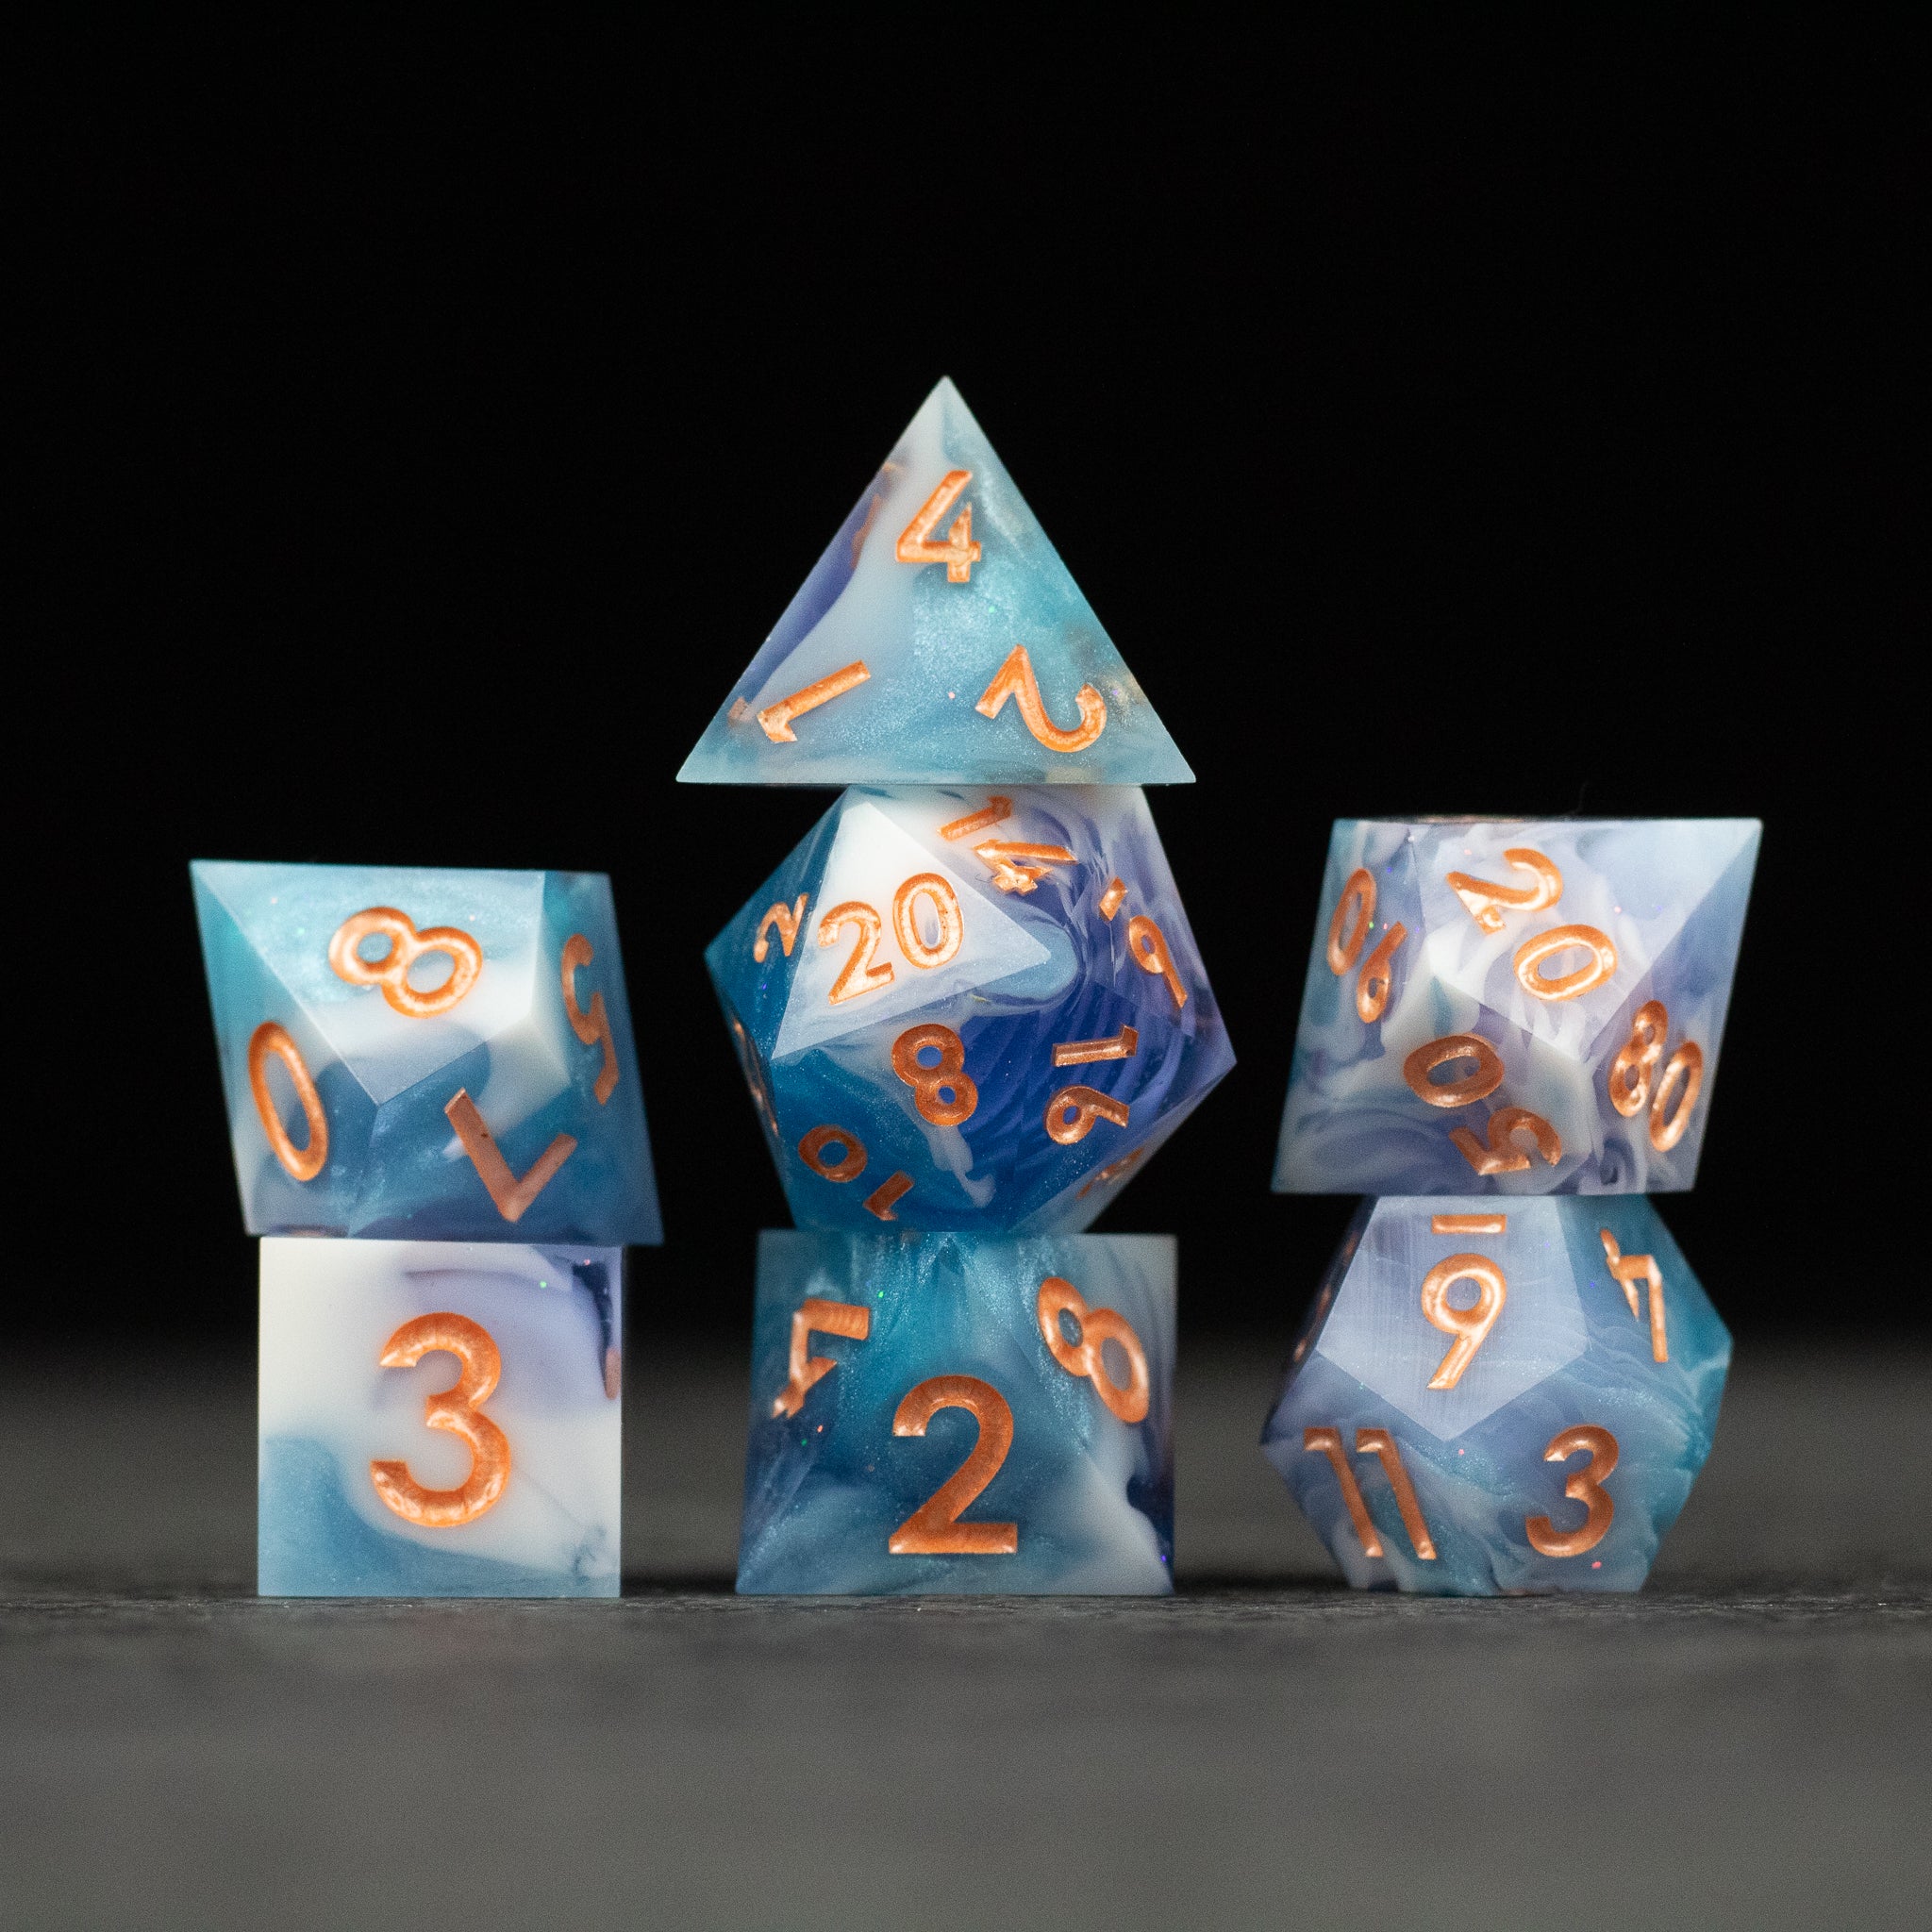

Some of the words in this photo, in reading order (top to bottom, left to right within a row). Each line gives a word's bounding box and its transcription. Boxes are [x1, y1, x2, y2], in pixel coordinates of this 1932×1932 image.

[896, 470, 981, 582] 4
[758, 659, 871, 742] 1
[974, 644, 1108, 753] 2
[328, 907, 483, 1019] 8
[753, 893, 809, 962] 2
[817, 873, 963, 1005] 20
[1446, 847, 1617, 1002] 20
[247, 1021, 328, 1182] 0
[891, 1023, 978, 1126] 8
[1044, 1024, 1140, 1145] 16
[1402, 1034, 1562, 1177] 50
[1608, 1000, 1704, 1153] 80
[444, 1087, 578, 1224] 7
[798, 1124, 915, 1221] 10
[1038, 1277, 1150, 1424] 8
[1600, 1228, 1669, 1364] 4
[370, 1312, 512, 1529] 3
[889, 1374, 1018, 1555] 2
[1303, 1427, 1437, 1560] 11
[1525, 1424, 1620, 1558] 3
